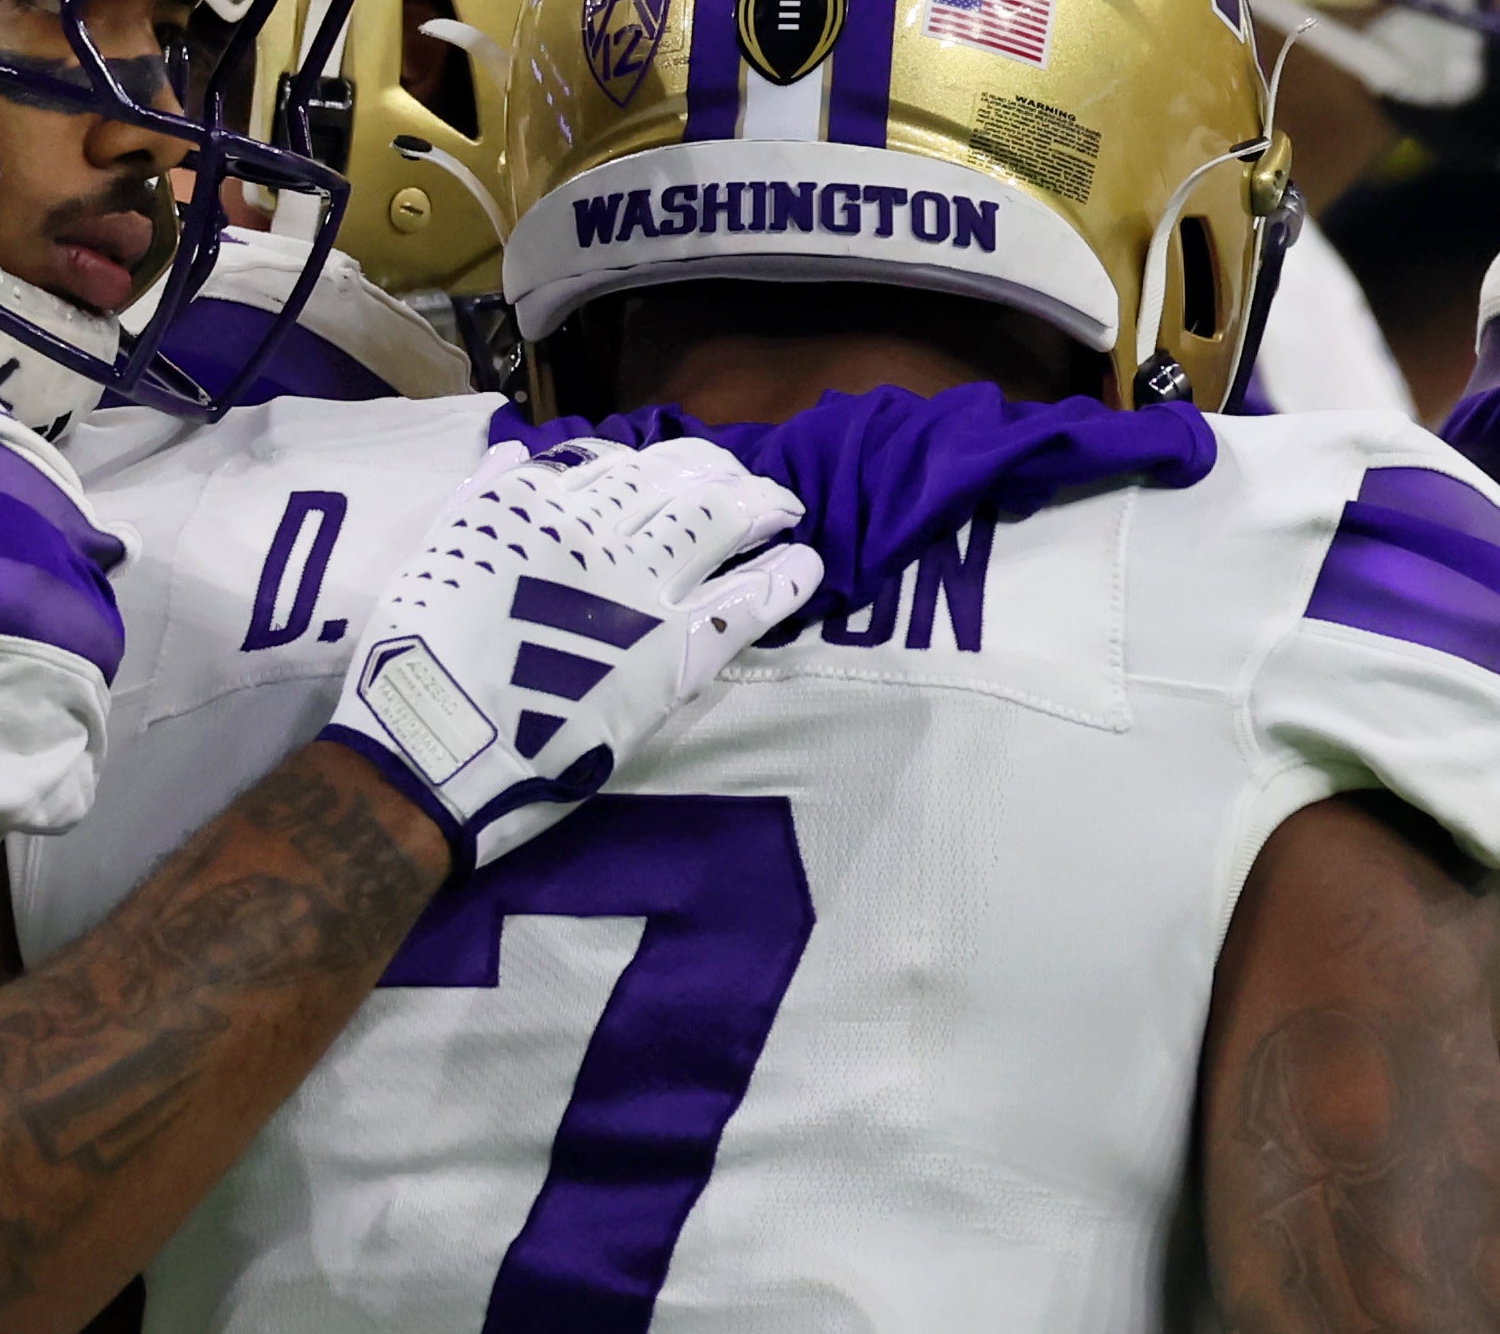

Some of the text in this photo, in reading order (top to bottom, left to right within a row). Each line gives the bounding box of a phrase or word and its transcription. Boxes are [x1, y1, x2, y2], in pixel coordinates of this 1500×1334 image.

[603, 24, 645, 81] 12
[1014, 94, 1077, 122] WARNING
[573, 180, 999, 253] WASHINGTON
[240, 491, 348, 653] D.
